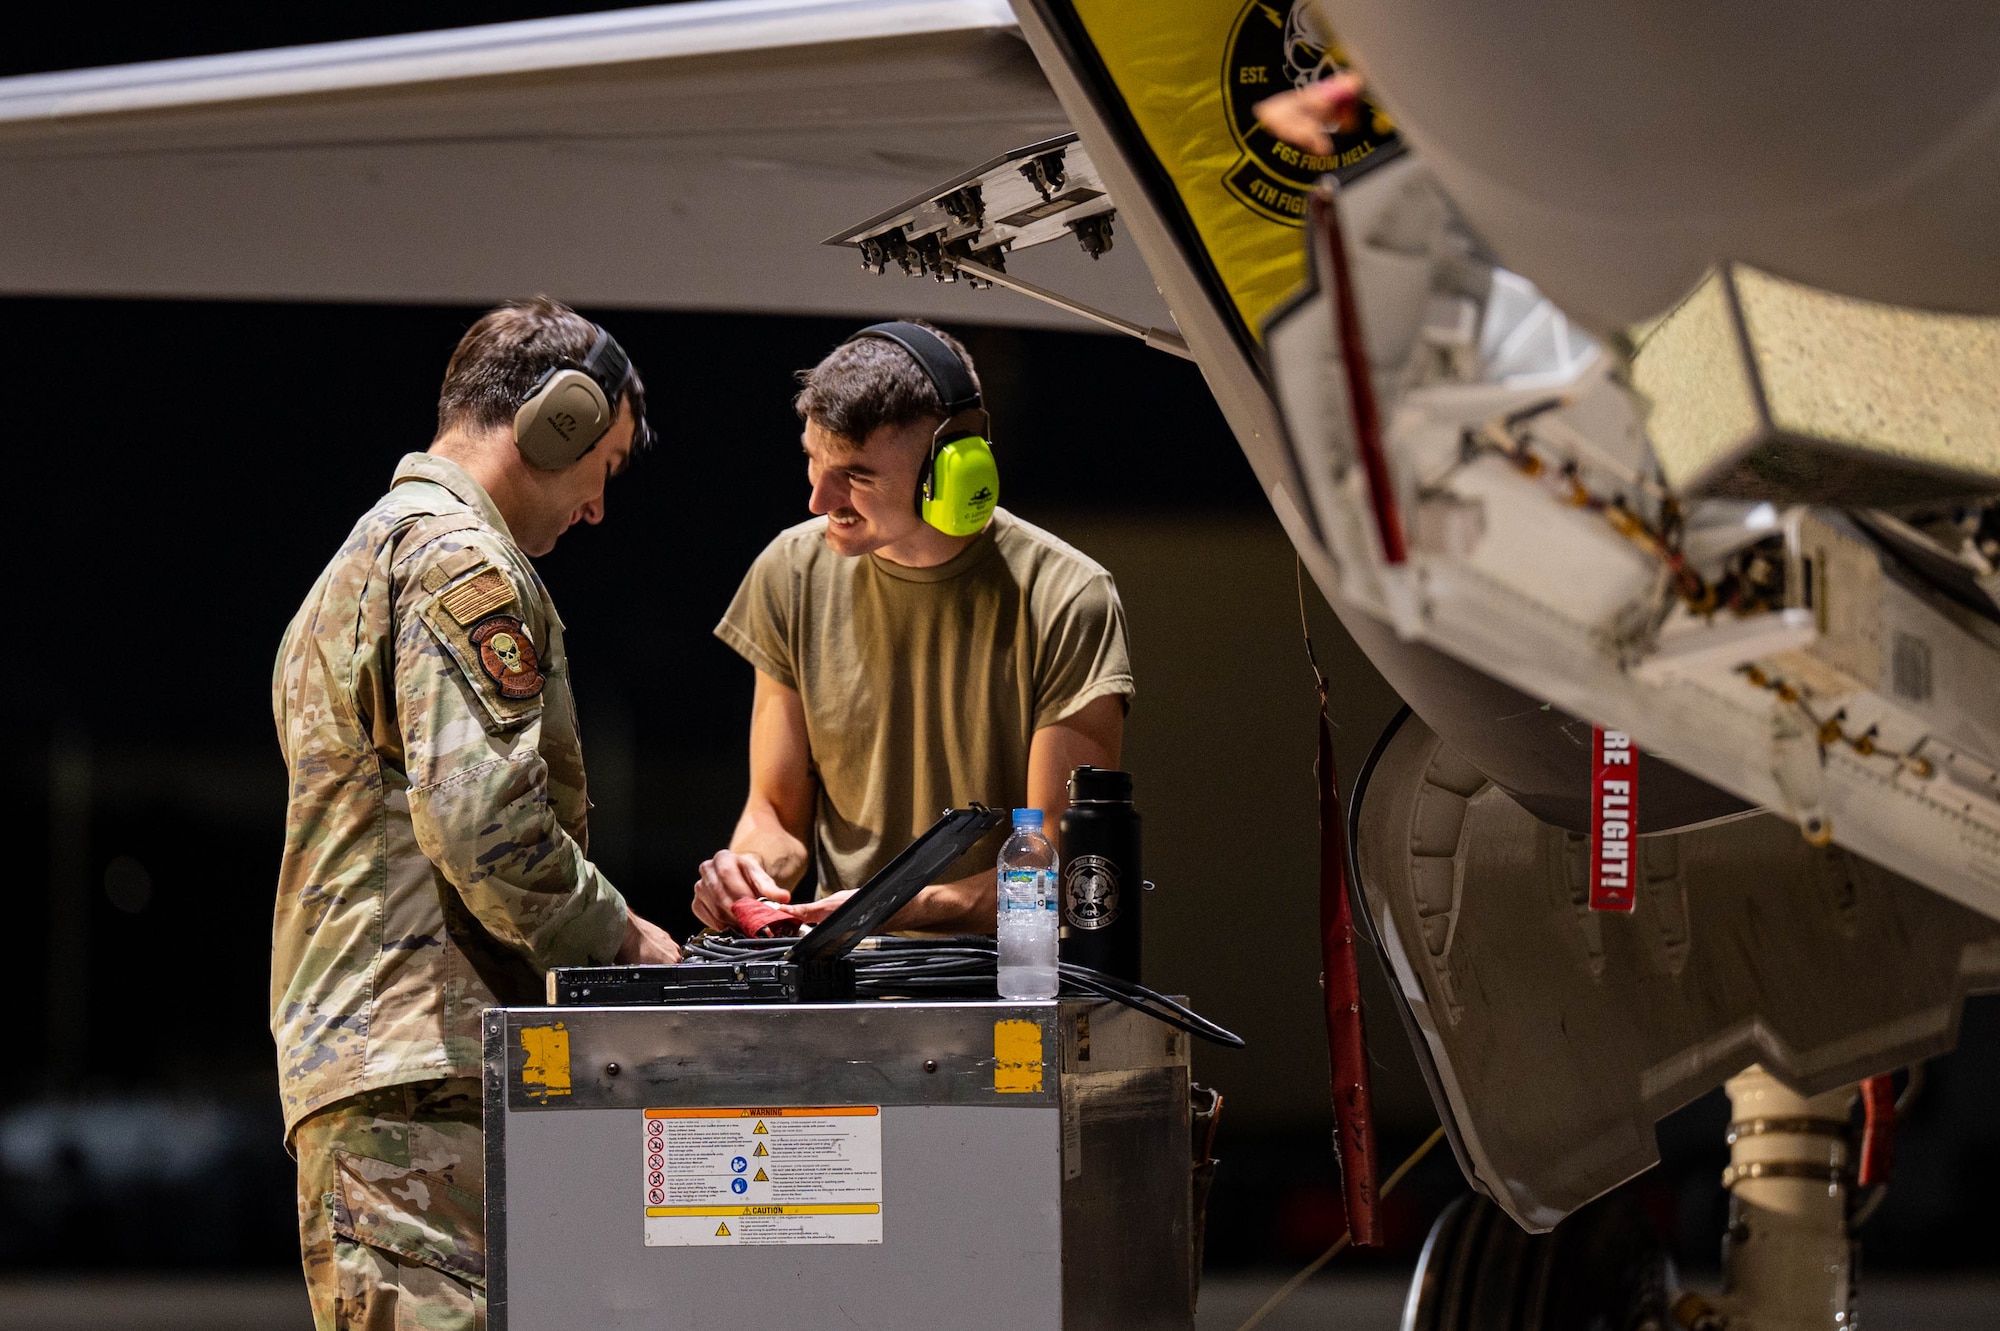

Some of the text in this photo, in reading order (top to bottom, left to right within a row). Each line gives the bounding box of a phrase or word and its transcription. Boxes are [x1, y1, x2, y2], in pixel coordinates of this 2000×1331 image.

[1240, 67, 1268, 83] EST.
[1272, 141, 1375, 171] FGS FROM HELL
[1249, 179, 1278, 204] 4TH
[1601, 780, 1630, 888] FLIGHT!
[750, 1108, 782, 1116] WARNING
[753, 1207, 783, 1215] CAUTION
